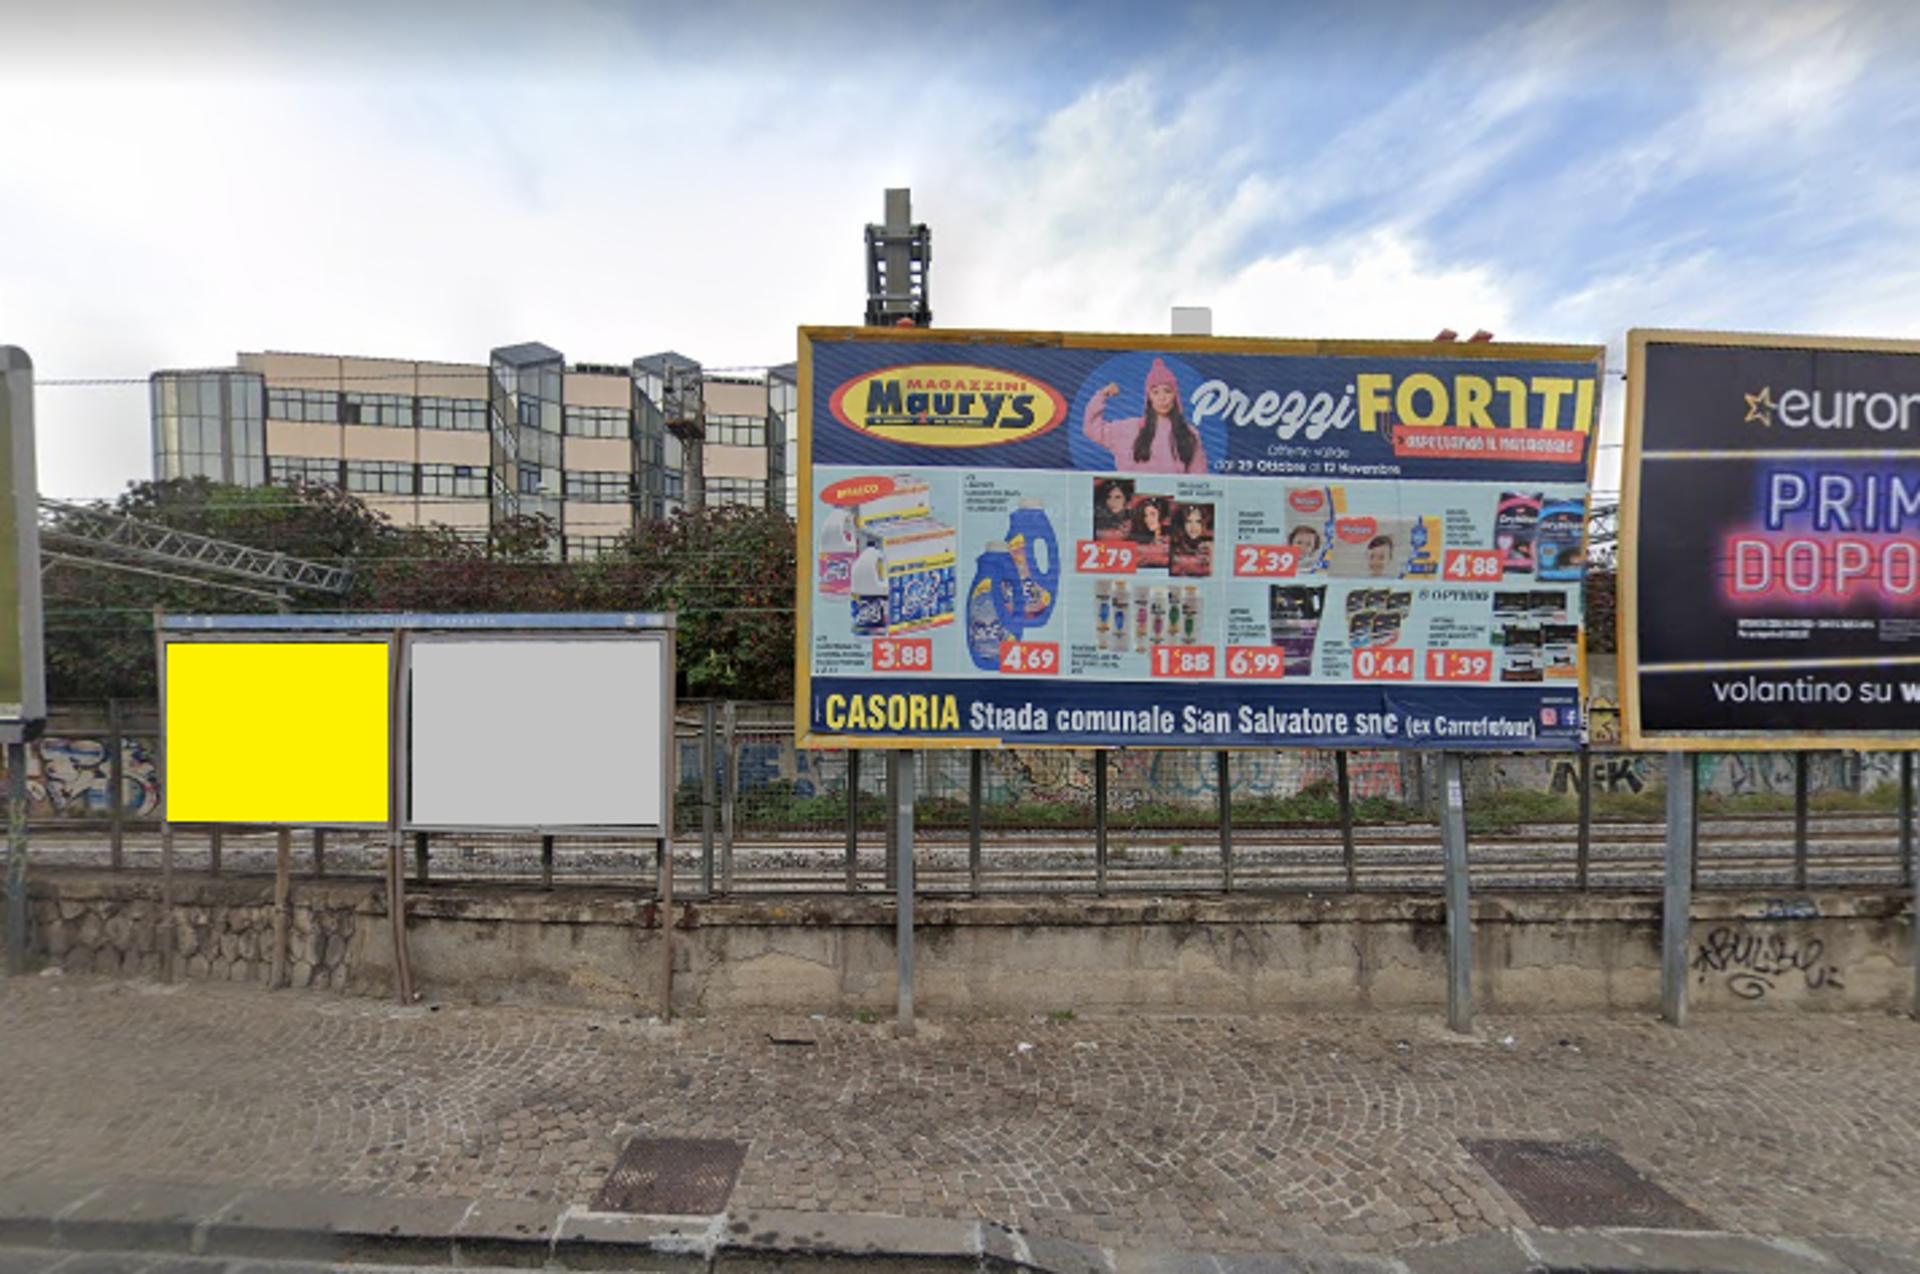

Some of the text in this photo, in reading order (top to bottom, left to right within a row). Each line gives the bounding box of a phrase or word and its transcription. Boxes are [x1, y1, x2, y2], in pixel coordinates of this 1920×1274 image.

[866, 380, 1035, 428] Maury's
[906, 379, 1027, 392] MAGAZZINI
[1190, 379, 1356, 441] Prezzi
[1734, 540, 1918, 595] DOPO
[1713, 676, 1851, 703] volantino
[1859, 682, 1892, 703] su
[825, 693, 961, 730] CASORIA
[969, 700, 1049, 731] Strada
[1056, 704, 1175, 734] comunale
[1182, 705, 1231, 734] San
[1238, 706, 1349, 735] Salvatore
[1356, 714, 1398, 735] snc
